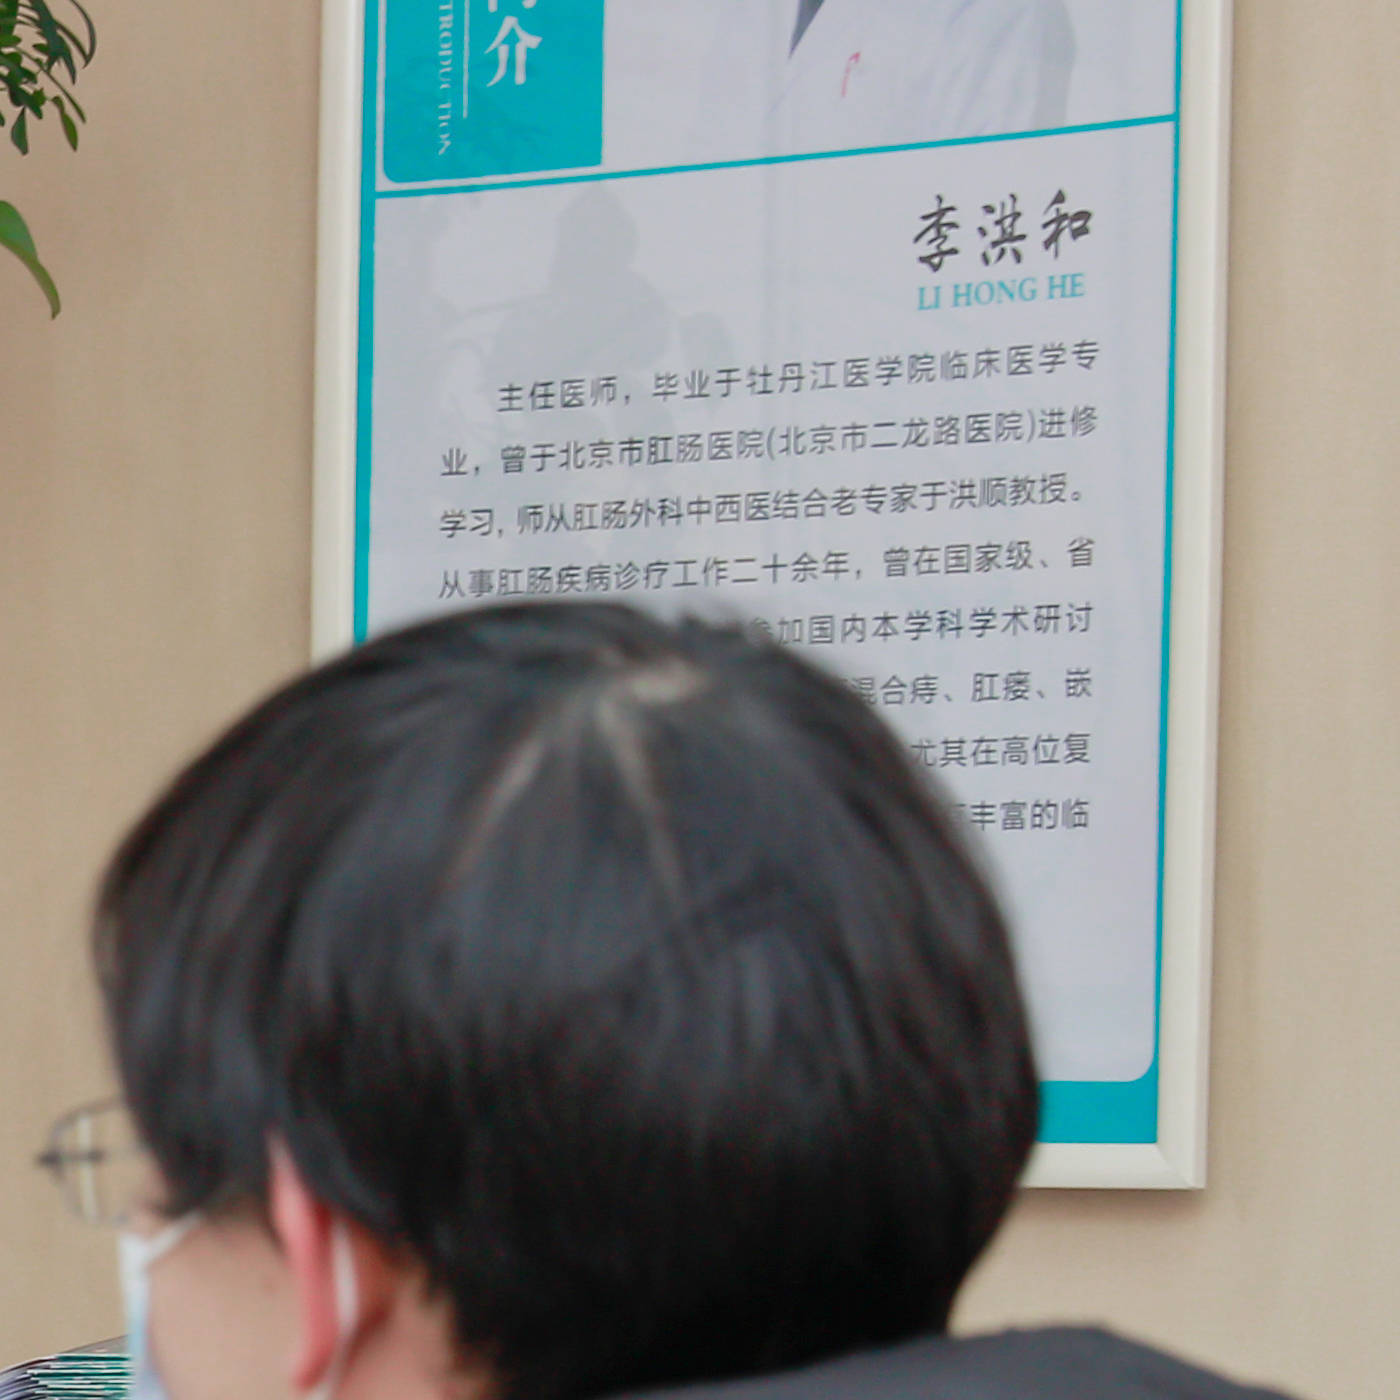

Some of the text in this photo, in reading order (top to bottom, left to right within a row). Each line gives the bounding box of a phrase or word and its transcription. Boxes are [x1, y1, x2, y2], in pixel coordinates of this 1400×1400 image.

[484, 0, 543, 86] 介
[913, 188, 1093, 273] 李洪和
[917, 271, 1086, 311] LI HONG HE
[497, 340, 1100, 413] 主任医师，毕业于牡丹江医学院临床医学专
[843, 667, 1093, 707] 混合痔、肛瘘、嵌
[911, 733, 1092, 768] 尤其在高位复
[955, 798, 1091, 832] 丰富的临
